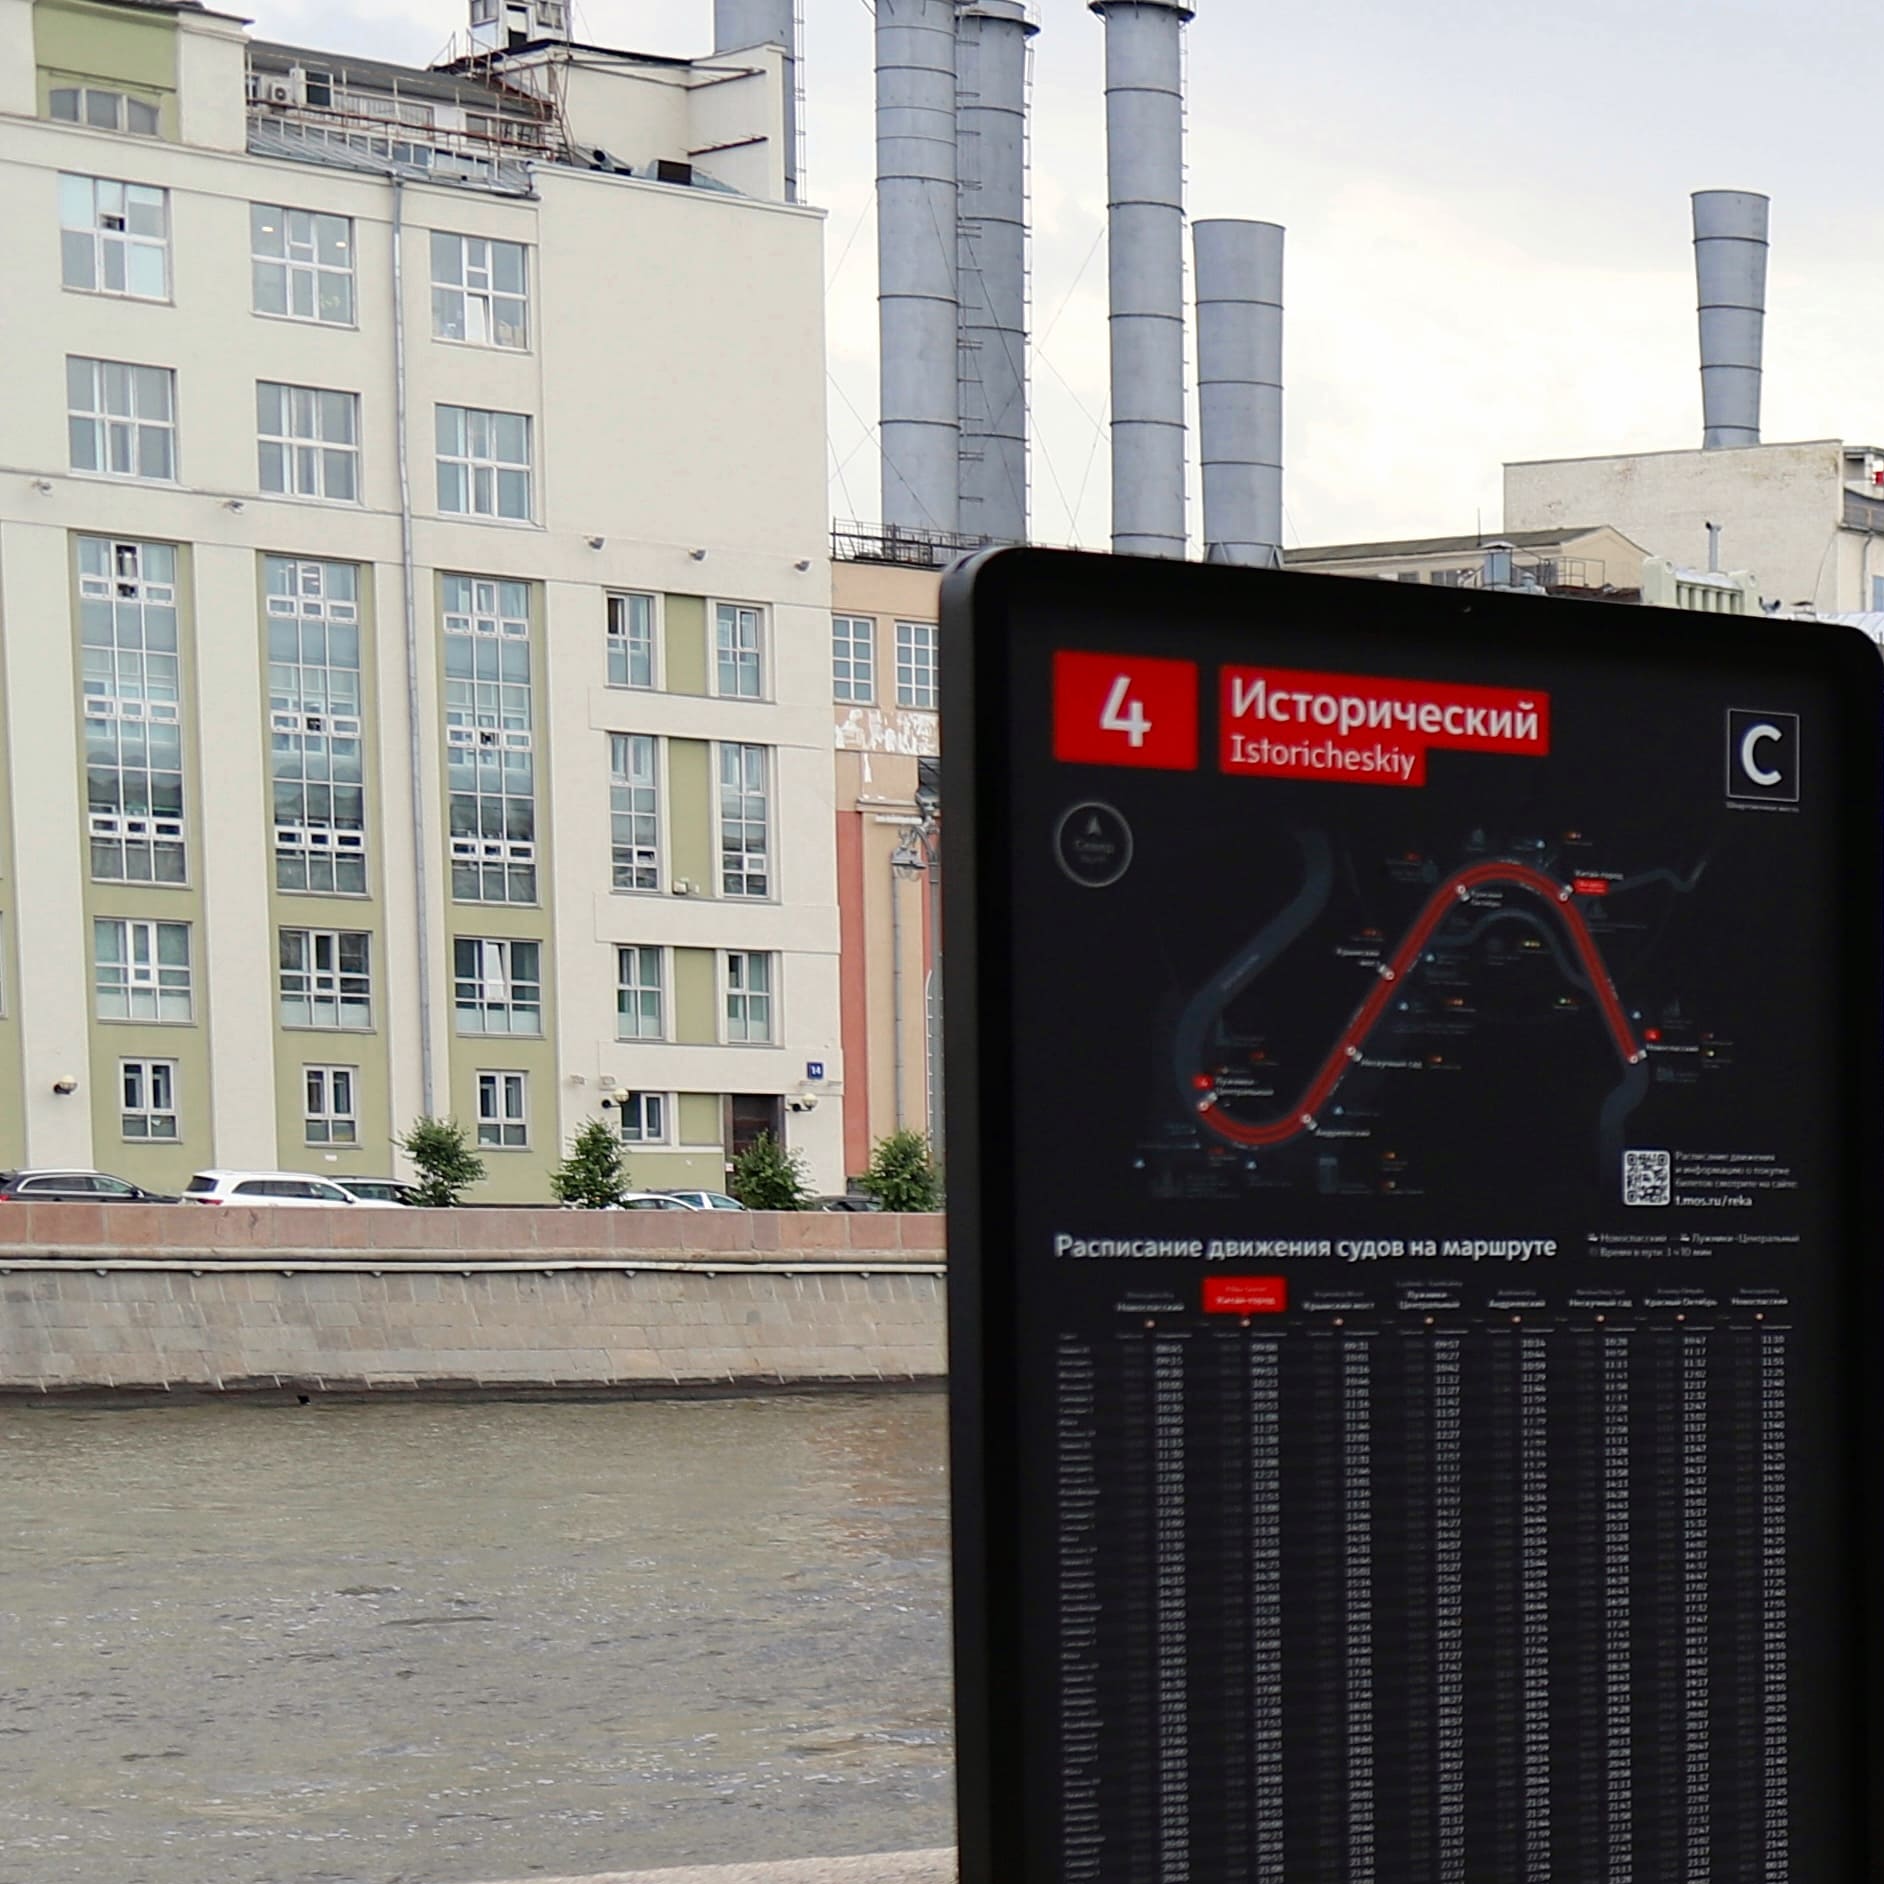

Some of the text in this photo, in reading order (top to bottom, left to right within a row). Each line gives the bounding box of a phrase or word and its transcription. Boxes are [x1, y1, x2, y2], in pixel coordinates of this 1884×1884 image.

[1099, 672, 1539, 748] 4 Исторический
[1230, 733, 1415, 781] Istoricheskiy
[1675, 1194, 1753, 1207] t.mos.ru/reka
[1054, 1233, 1558, 1264] Расписание движения судов на маршруте
